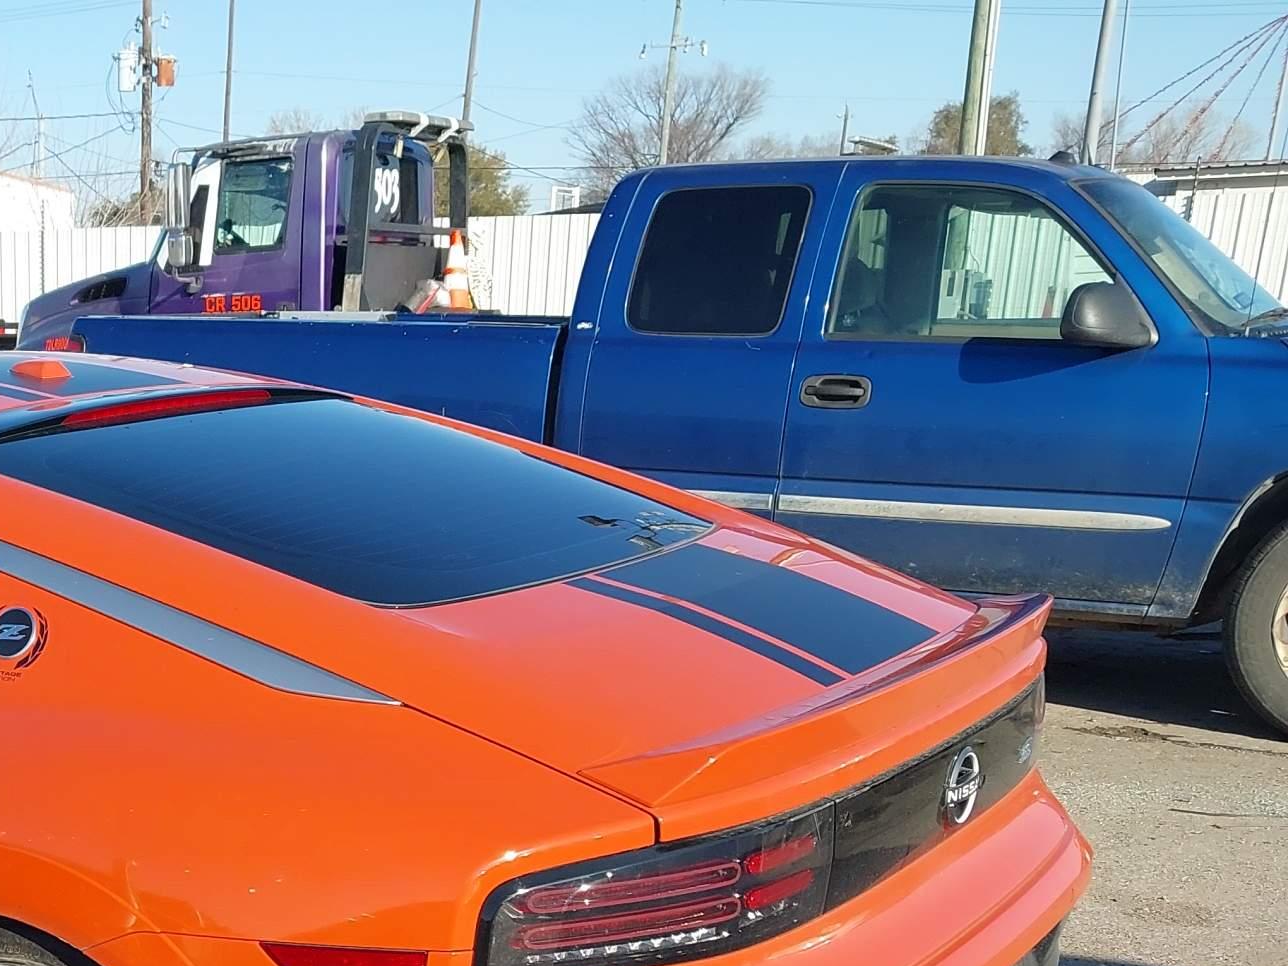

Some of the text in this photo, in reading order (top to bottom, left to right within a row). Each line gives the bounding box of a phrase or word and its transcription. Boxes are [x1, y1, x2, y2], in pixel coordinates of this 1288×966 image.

[374, 167, 400, 214] 503
[206, 295, 261, 312] CR 506
